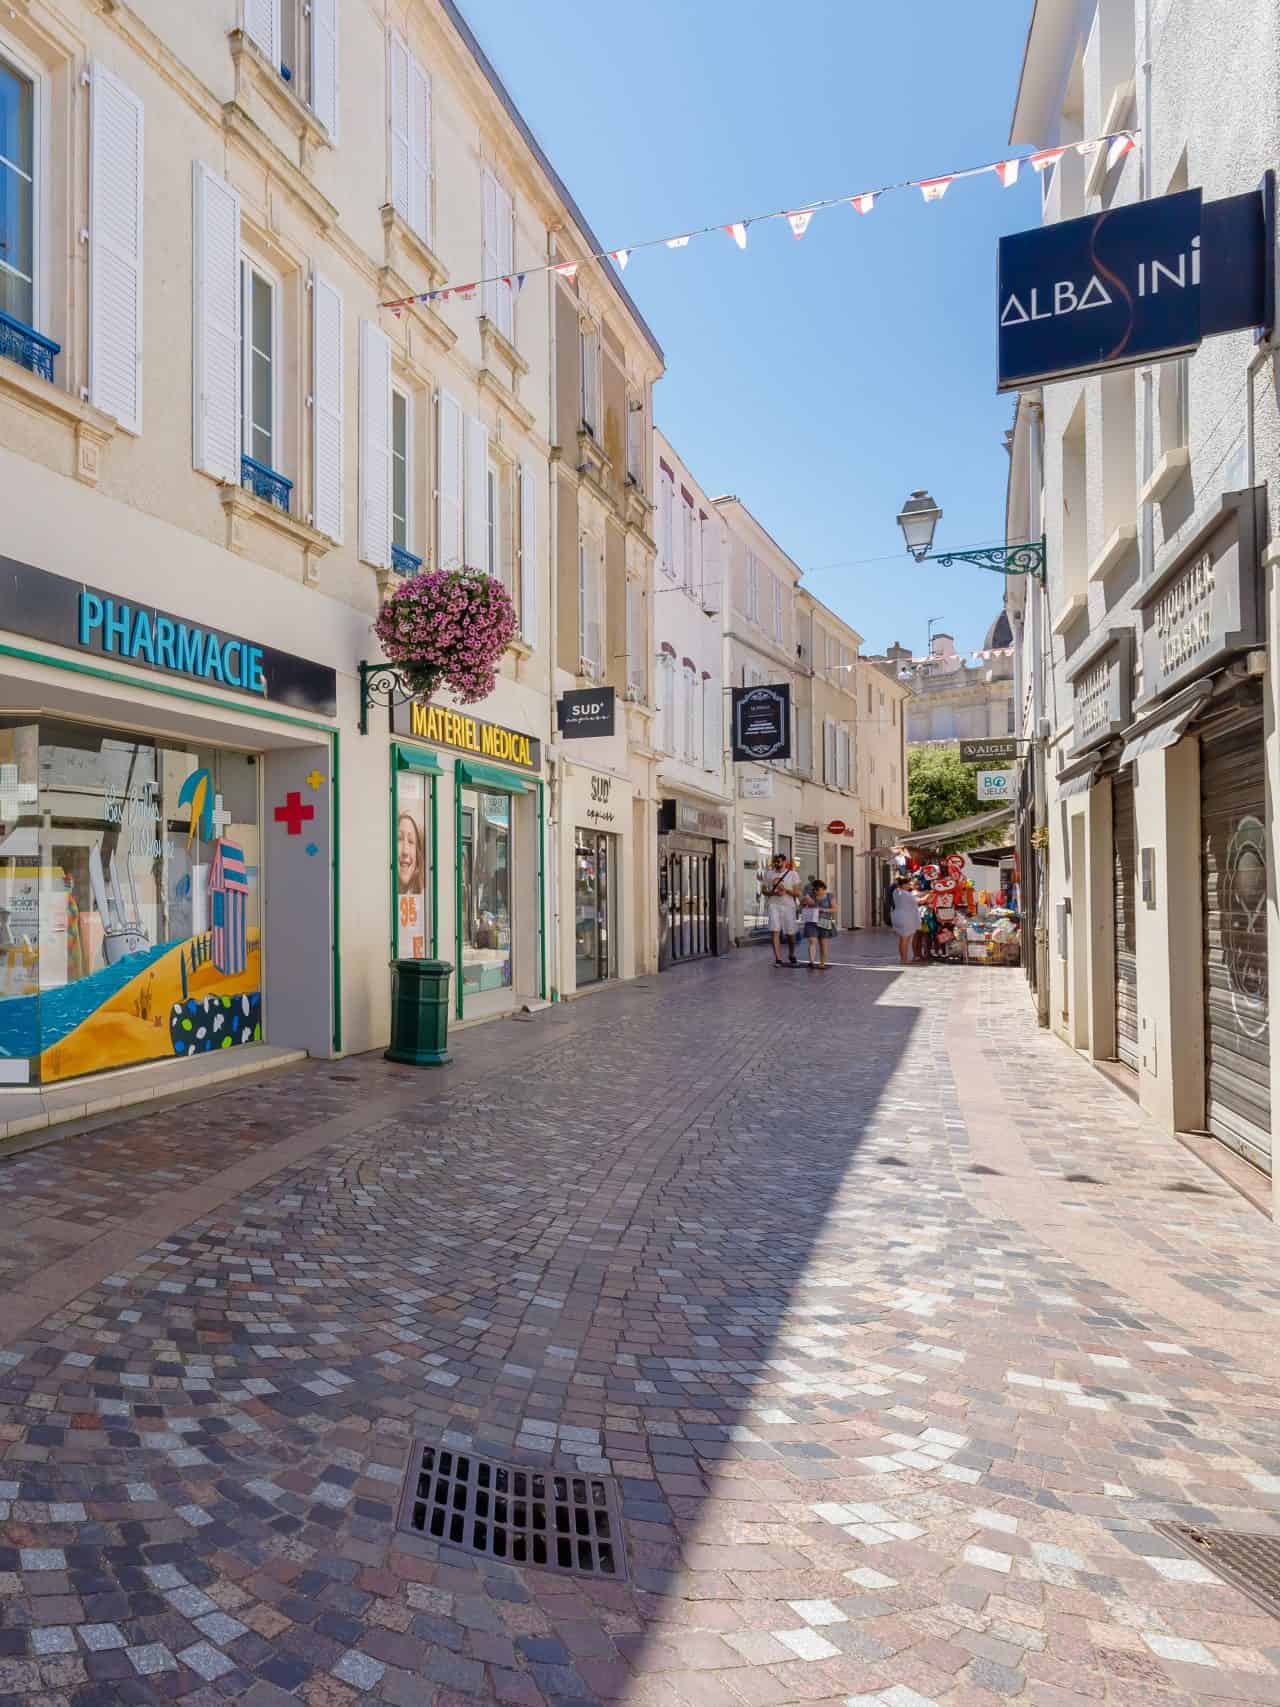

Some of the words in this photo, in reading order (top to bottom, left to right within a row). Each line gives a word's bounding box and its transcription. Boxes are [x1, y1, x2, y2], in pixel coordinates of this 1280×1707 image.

[79, 591, 265, 693] PHARMACIE
[410, 701, 480, 751] MATÉRIEL
[482, 724, 533, 765] MÉDICAL
[976, 745, 1014, 753] AIGLE
